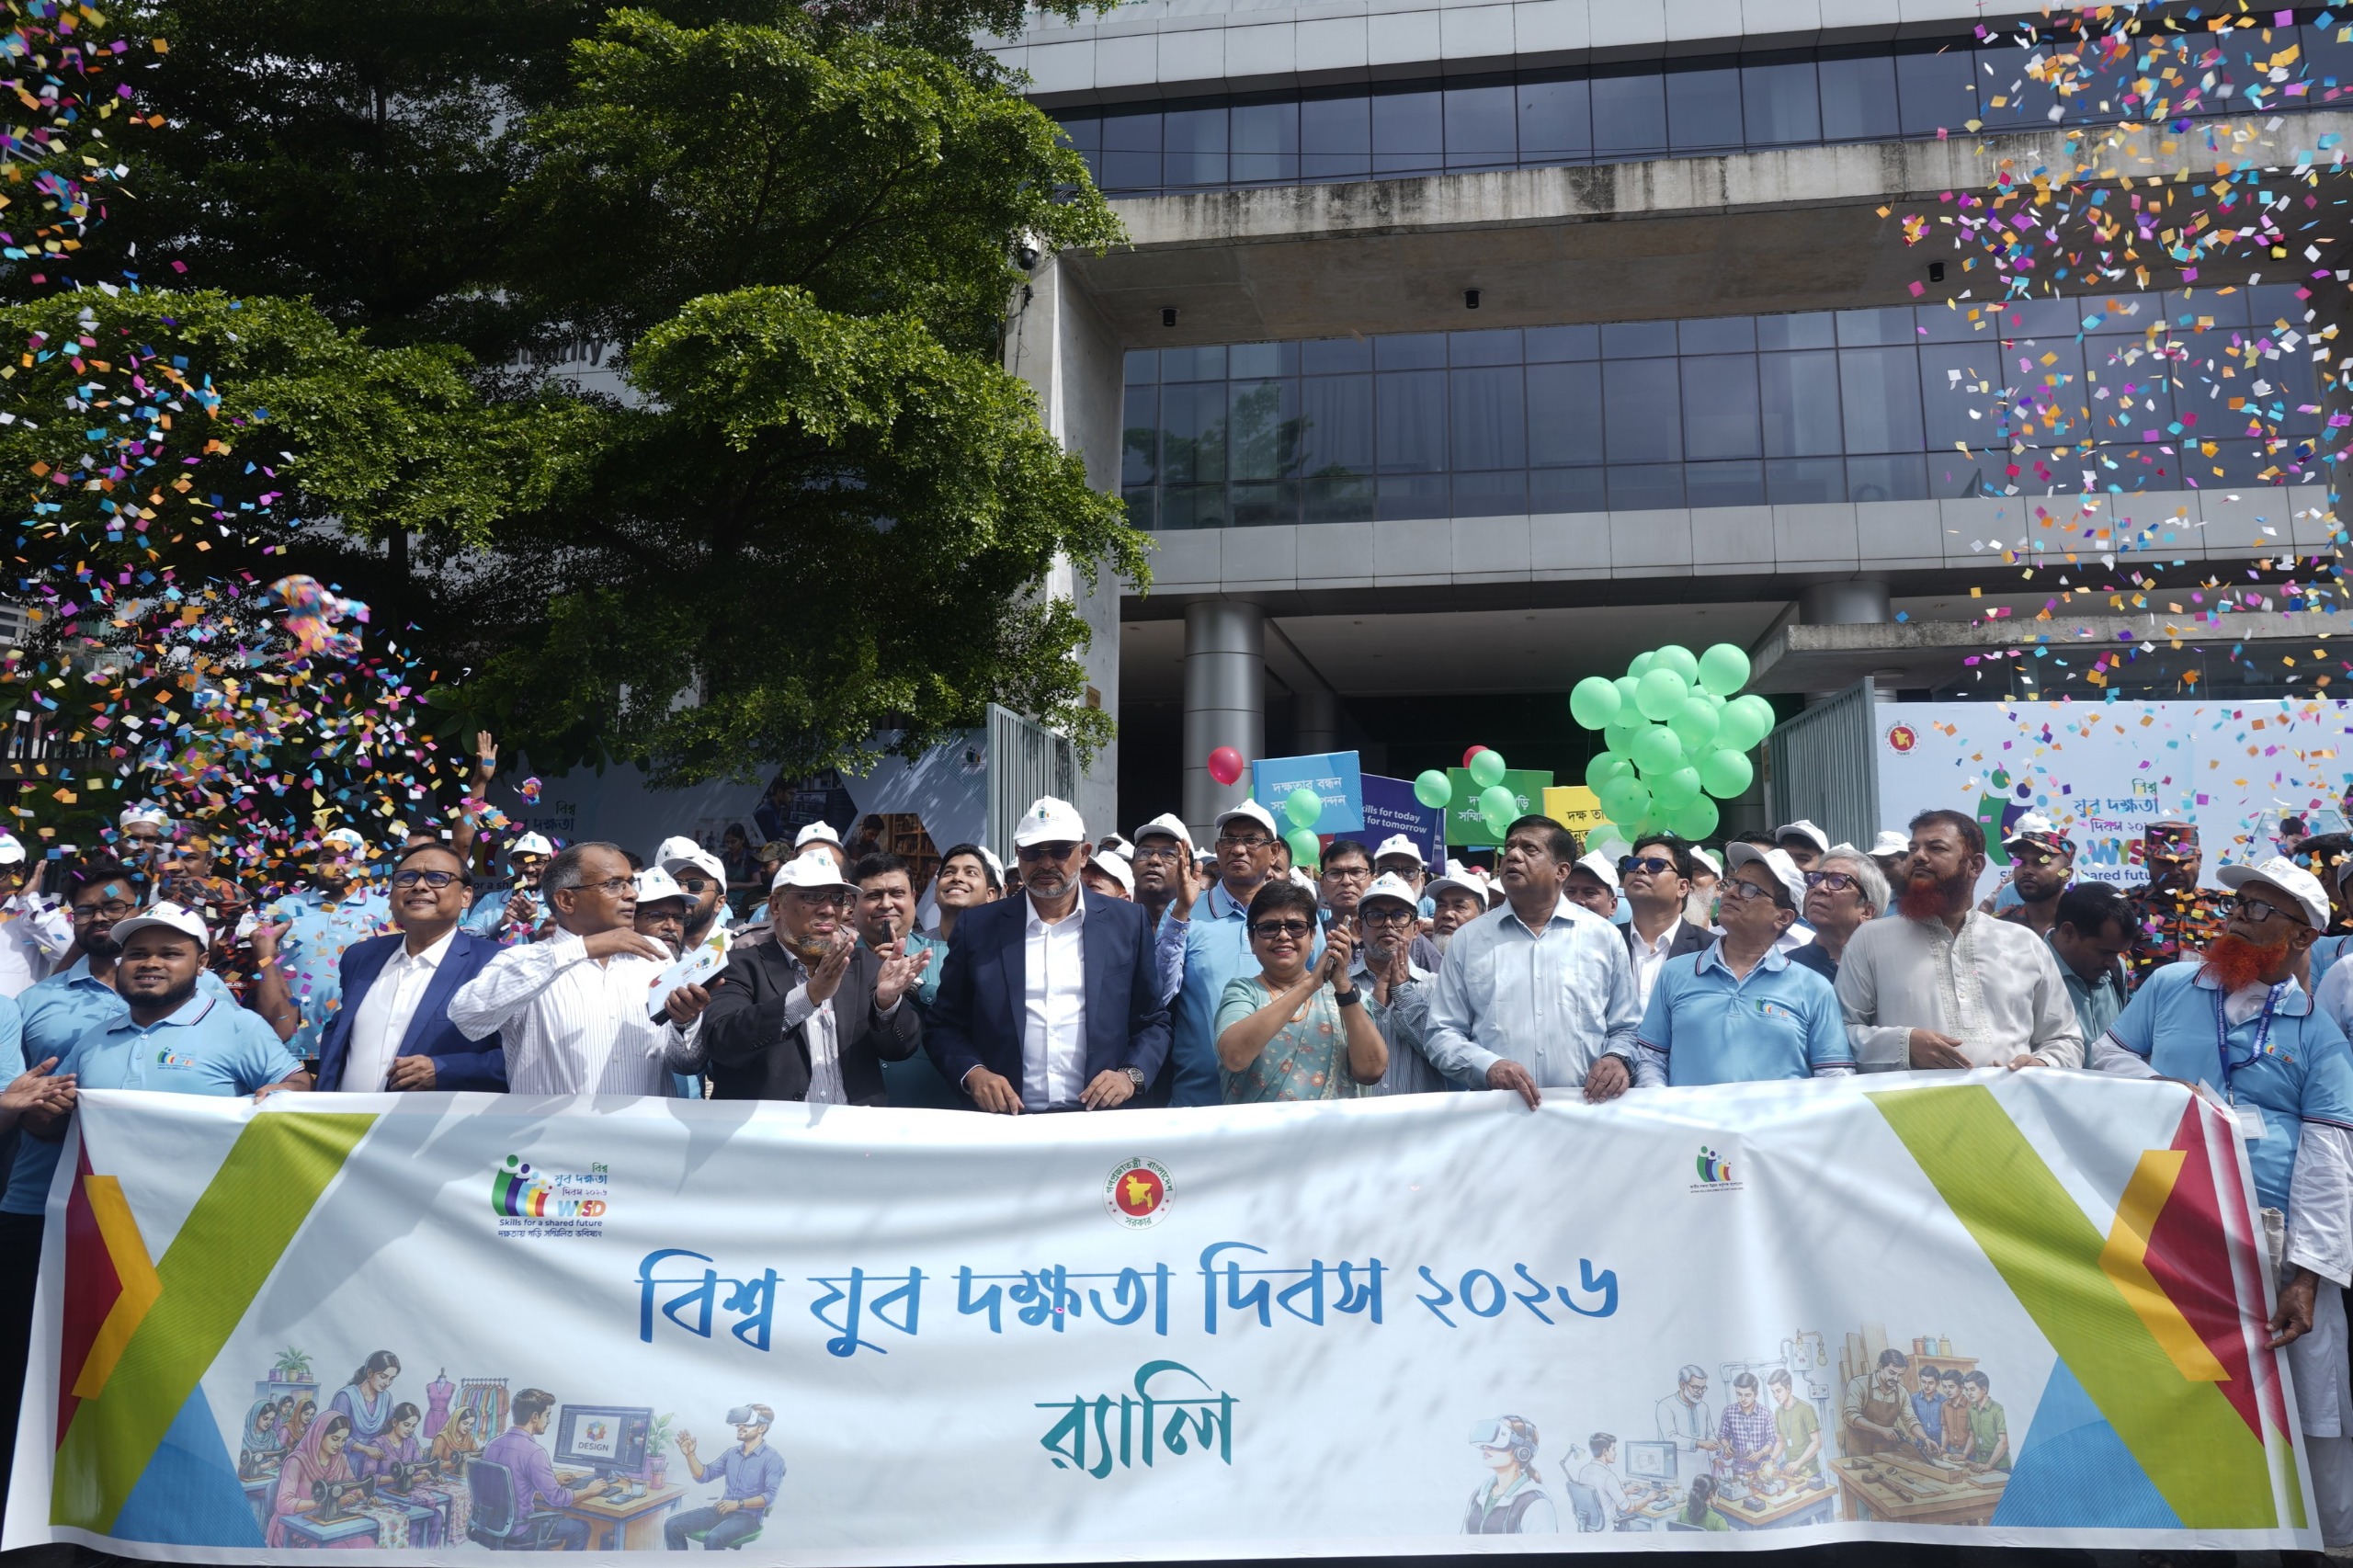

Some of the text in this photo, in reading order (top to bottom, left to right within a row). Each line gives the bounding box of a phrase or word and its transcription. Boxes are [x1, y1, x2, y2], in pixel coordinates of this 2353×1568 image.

[2107, 798, 2159, 814] দক্ষতা
[1380, 807, 1392, 817] for
[1394, 811, 1421, 824] today
[1367, 815, 1380, 825] for
[1381, 819, 1427, 834] tomorrow
[2086, 838, 2146, 865] WYS
[592, 1163, 608, 1174] বিশ্ব
[1146, 1160, 1174, 1192] বাংলাদেশ
[554, 1175, 608, 1187] যুব দক্ষতা
[563, 1187, 583, 1197] দিবস
[557, 1200, 607, 1217] WYSD
[499, 1219, 522, 1227] Skills
[524, 1219, 536, 1227] for
[545, 1219, 574, 1227] shared
[575, 1219, 603, 1227] future
[1125, 1216, 1153, 1227] সরকার
[528, 1228, 542, 1239] গড়ি
[634, 1241, 1620, 1358] বিশ্ব যুব দক্ষতা দিবস ২০২৬
[1033, 1359, 1240, 1480] র‍্যালি
[578, 1441, 609, 1452] DESIGN
